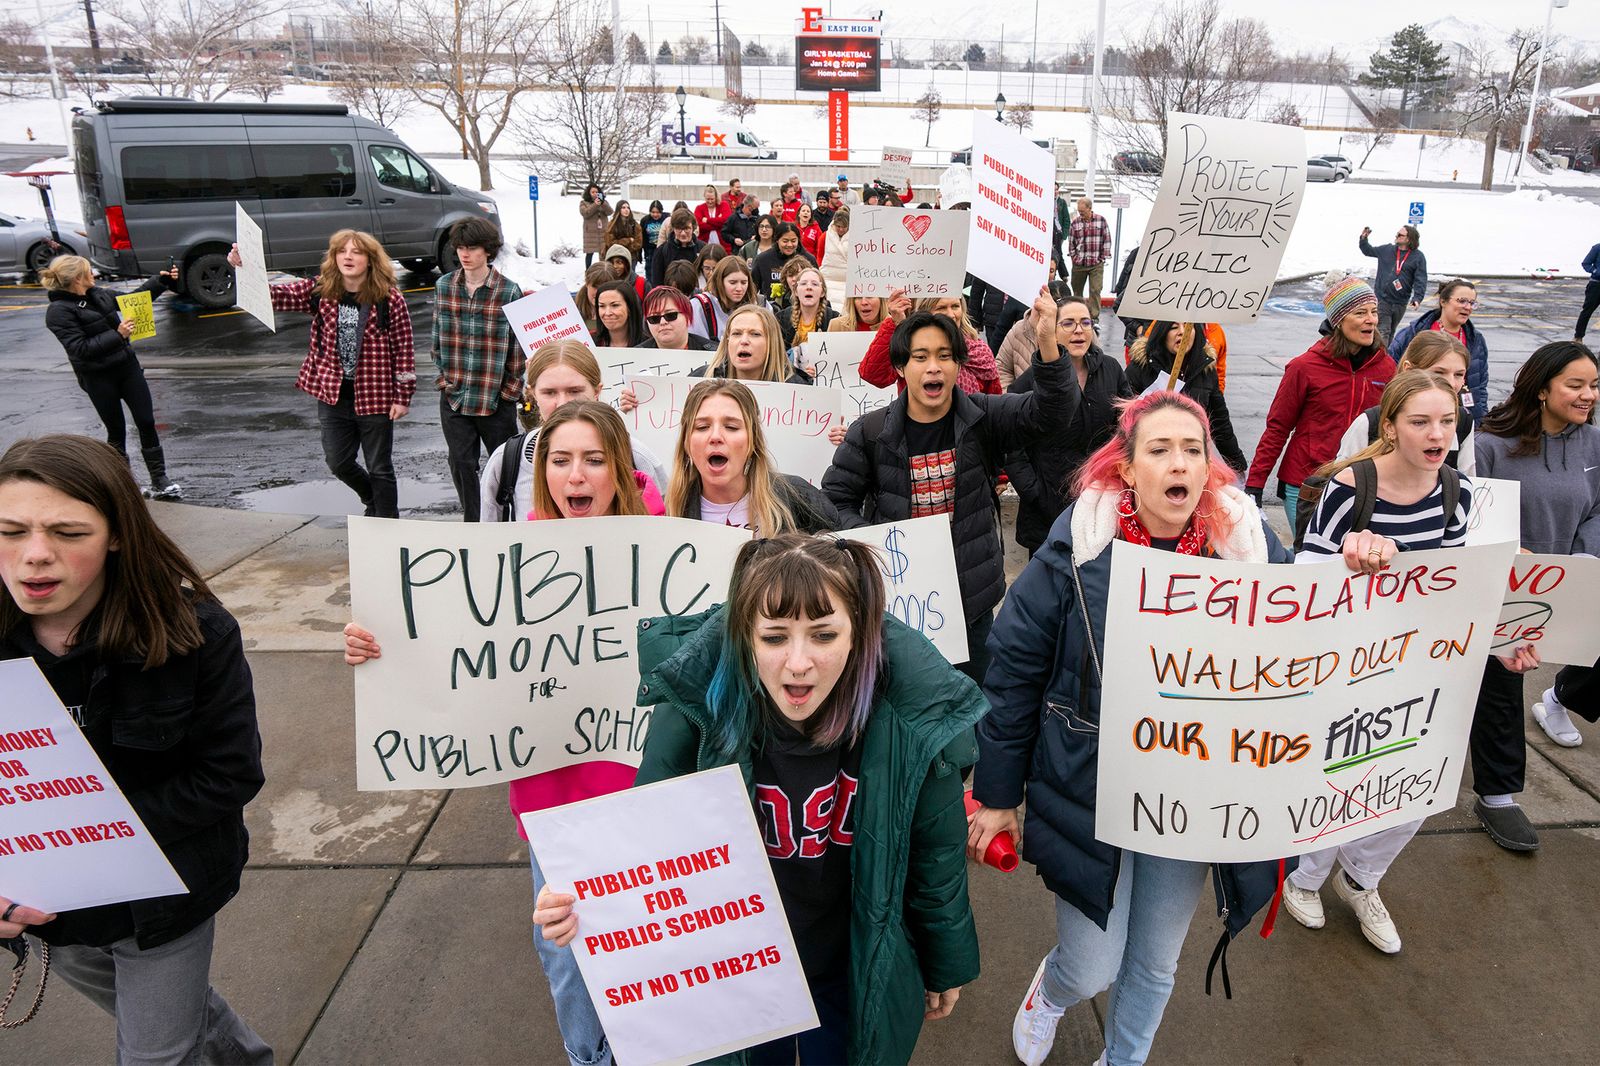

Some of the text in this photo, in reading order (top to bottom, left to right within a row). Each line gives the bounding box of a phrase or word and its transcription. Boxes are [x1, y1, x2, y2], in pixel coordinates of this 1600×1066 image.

[802, 8, 822, 32] E
[804, 50, 872, 59] GIRL'S BASKETBALL
[833, 61, 840, 69] @
[661, 124, 727, 147] FedEx
[883, 153, 911, 165] DESTROY
[1176, 123, 1298, 197] PROTECT
[983, 153, 1044, 199] PUBLIC MONEY
[1006, 183, 1023, 202] FOR
[862, 209, 883, 233] I
[978, 182, 1009, 210] PUBLIC
[1010, 202, 1047, 233] SCHOOLS
[1209, 201, 1259, 232] YOUR
[854, 238, 897, 259] public
[976, 215, 1045, 265] SAY NO TO HB215
[1140, 227, 1251, 278] PUBLIC
[855, 265, 931, 279] teachers.
[854, 283, 876, 296] NO
[904, 284, 922, 296] HB
[926, 283, 948, 294] 215
[1136, 279, 1269, 318] SCHOOLS!
[523, 307, 569, 332] PUBLIC MONEY
[544, 323, 558, 334] FOR
[552, 323, 582, 341] SCHOOLS
[819, 341, 828, 355] A
[399, 542, 711, 639] PUBLIC
[1139, 565, 1457, 627] LEGISLATORS
[451, 624, 629, 690] MONE
[1150, 622, 1475, 693] WALKED OUT ON
[529, 677, 567, 702] FOR
[373, 707, 651, 782] PUBLIC SCHO
[1132, 717, 1210, 761] OUR
[1230, 728, 1312, 768] KIDS
[0, 759, 30, 780] OR
[14, 774, 105, 802] SCHOOLS
[1132, 757, 1448, 840] NO TO VOUCHERS!
[0, 820, 136, 857] AY NO TO HB215
[573, 843, 731, 901] PUBLIC MONEY
[643, 887, 688, 915] FOR
[584, 893, 766, 956] PUBLIC SCHOOLS
[605, 945, 782, 1008] SAY NO TO HB215
